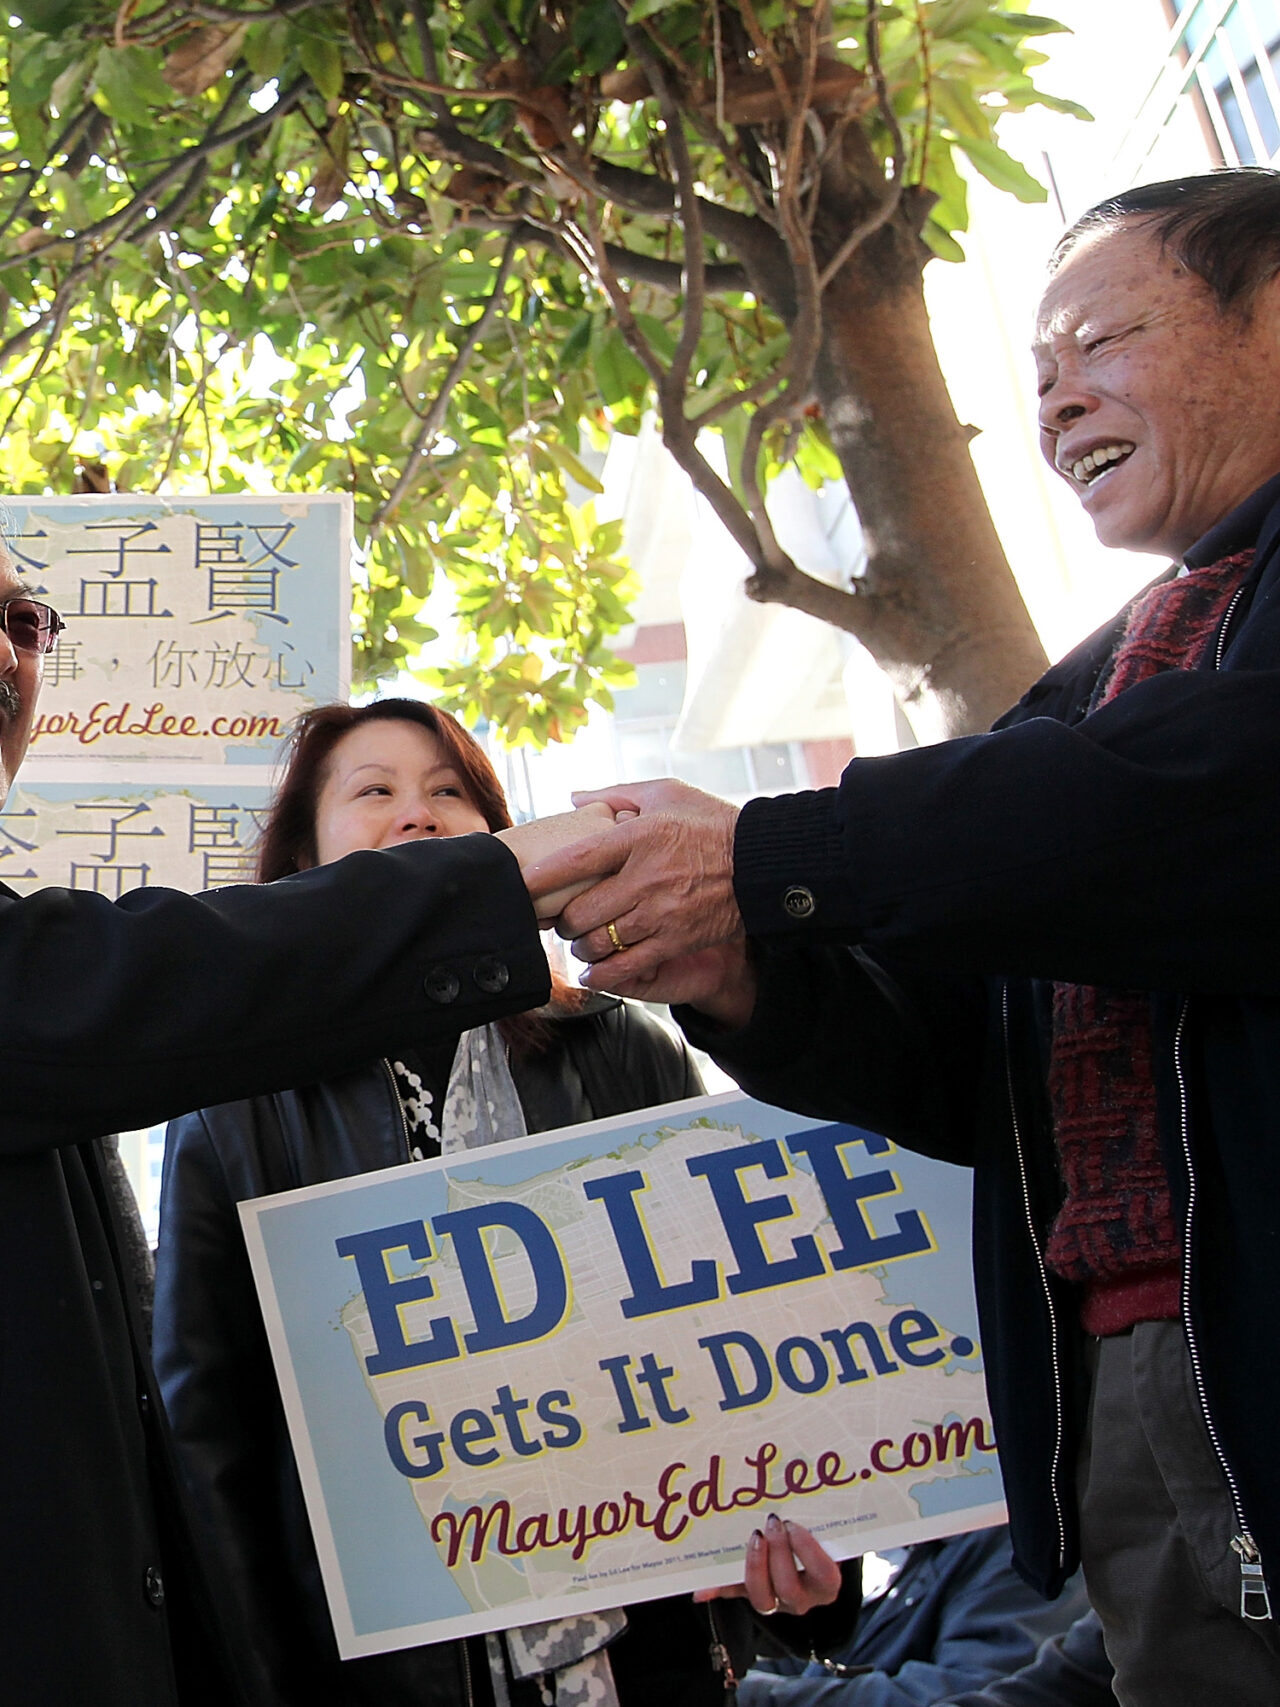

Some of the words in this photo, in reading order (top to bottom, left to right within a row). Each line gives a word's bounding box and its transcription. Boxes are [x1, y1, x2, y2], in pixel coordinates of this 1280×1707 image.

[335, 1201, 568, 1376] ED
[584, 1121, 934, 1319] LEE
[384, 1385, 582, 1478] Gets
[599, 1353, 690, 1433] It
[699, 1310, 976, 1411] Done.
[431, 1417, 998, 1567] MayorEdLee.com
